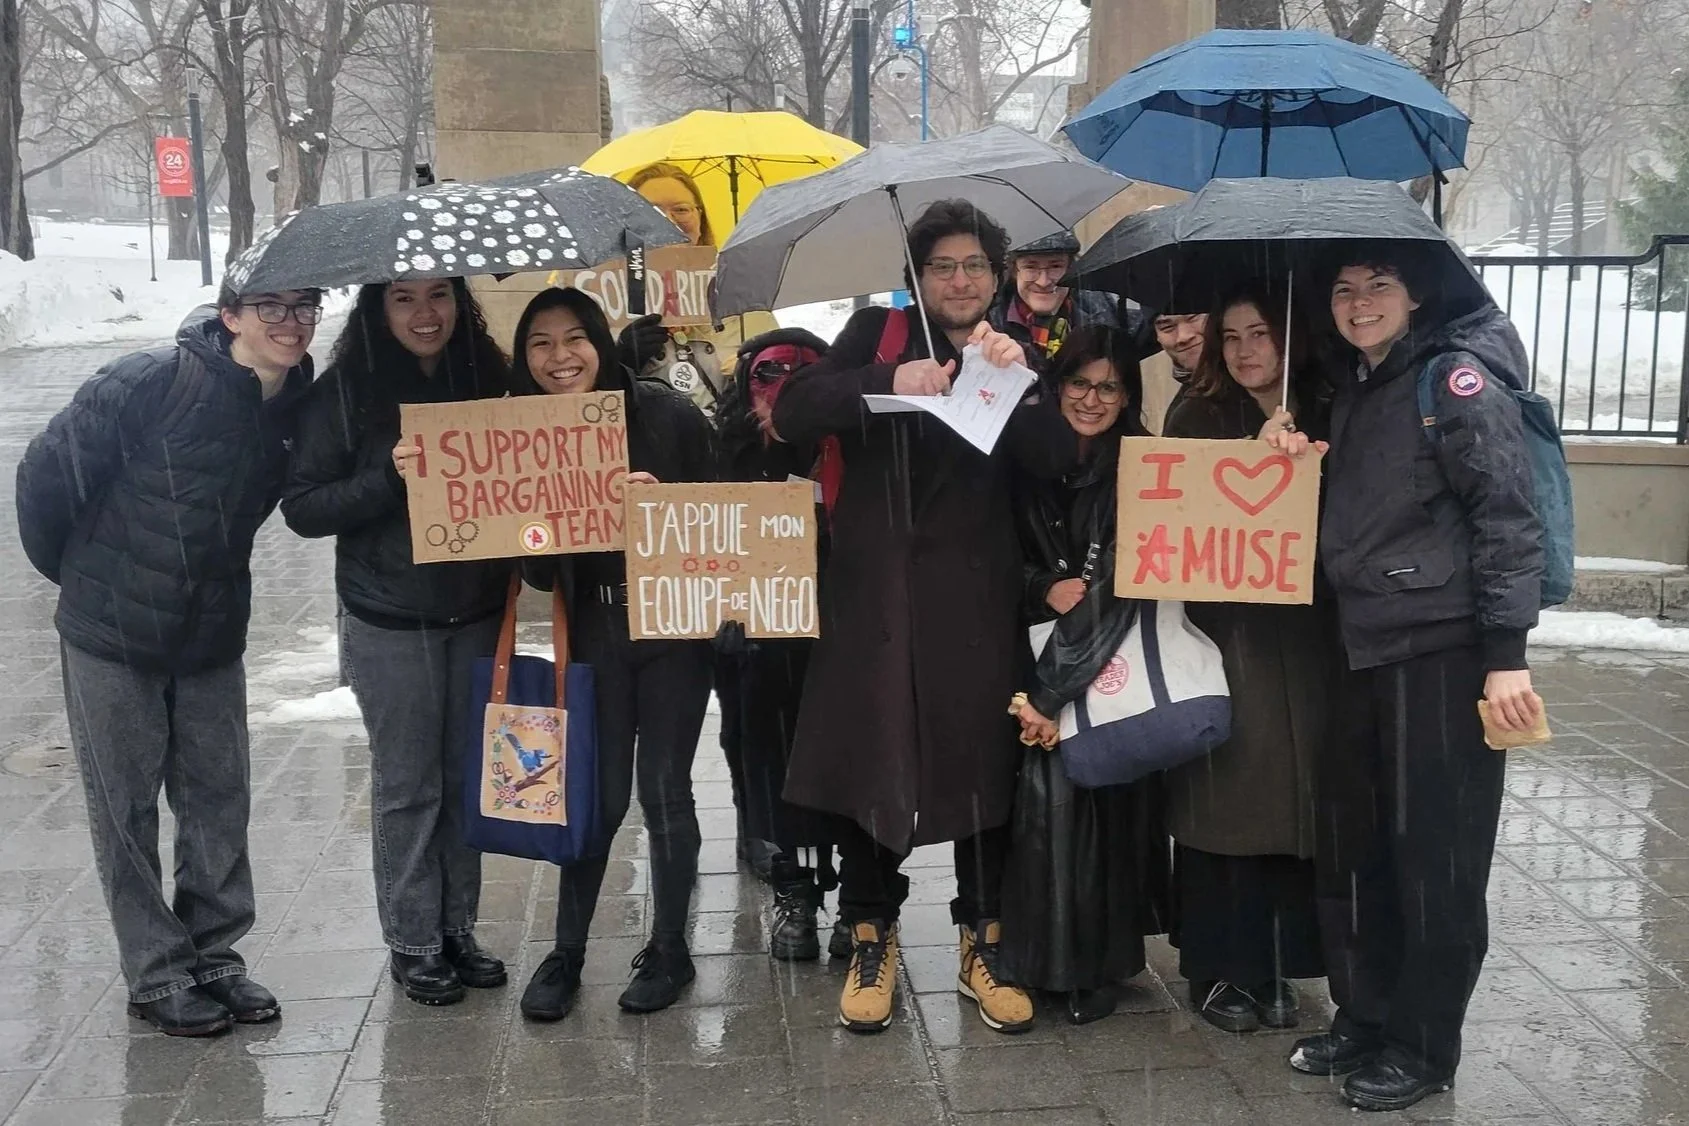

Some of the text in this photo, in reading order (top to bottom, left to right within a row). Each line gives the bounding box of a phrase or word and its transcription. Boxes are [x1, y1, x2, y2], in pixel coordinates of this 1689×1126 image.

[165, 154, 183, 166] 24
[674, 379, 691, 390] CSN
[414, 425, 626, 479] I SUPPORT MY
[1138, 453, 1186, 500] I
[447, 466, 627, 524] BARGAINING
[636, 501, 806, 557] J'APPUIE MON
[1132, 524, 1301, 593] AMUSE
[731, 592, 749, 611] DE
[748, 565, 815, 635] NÉGO
